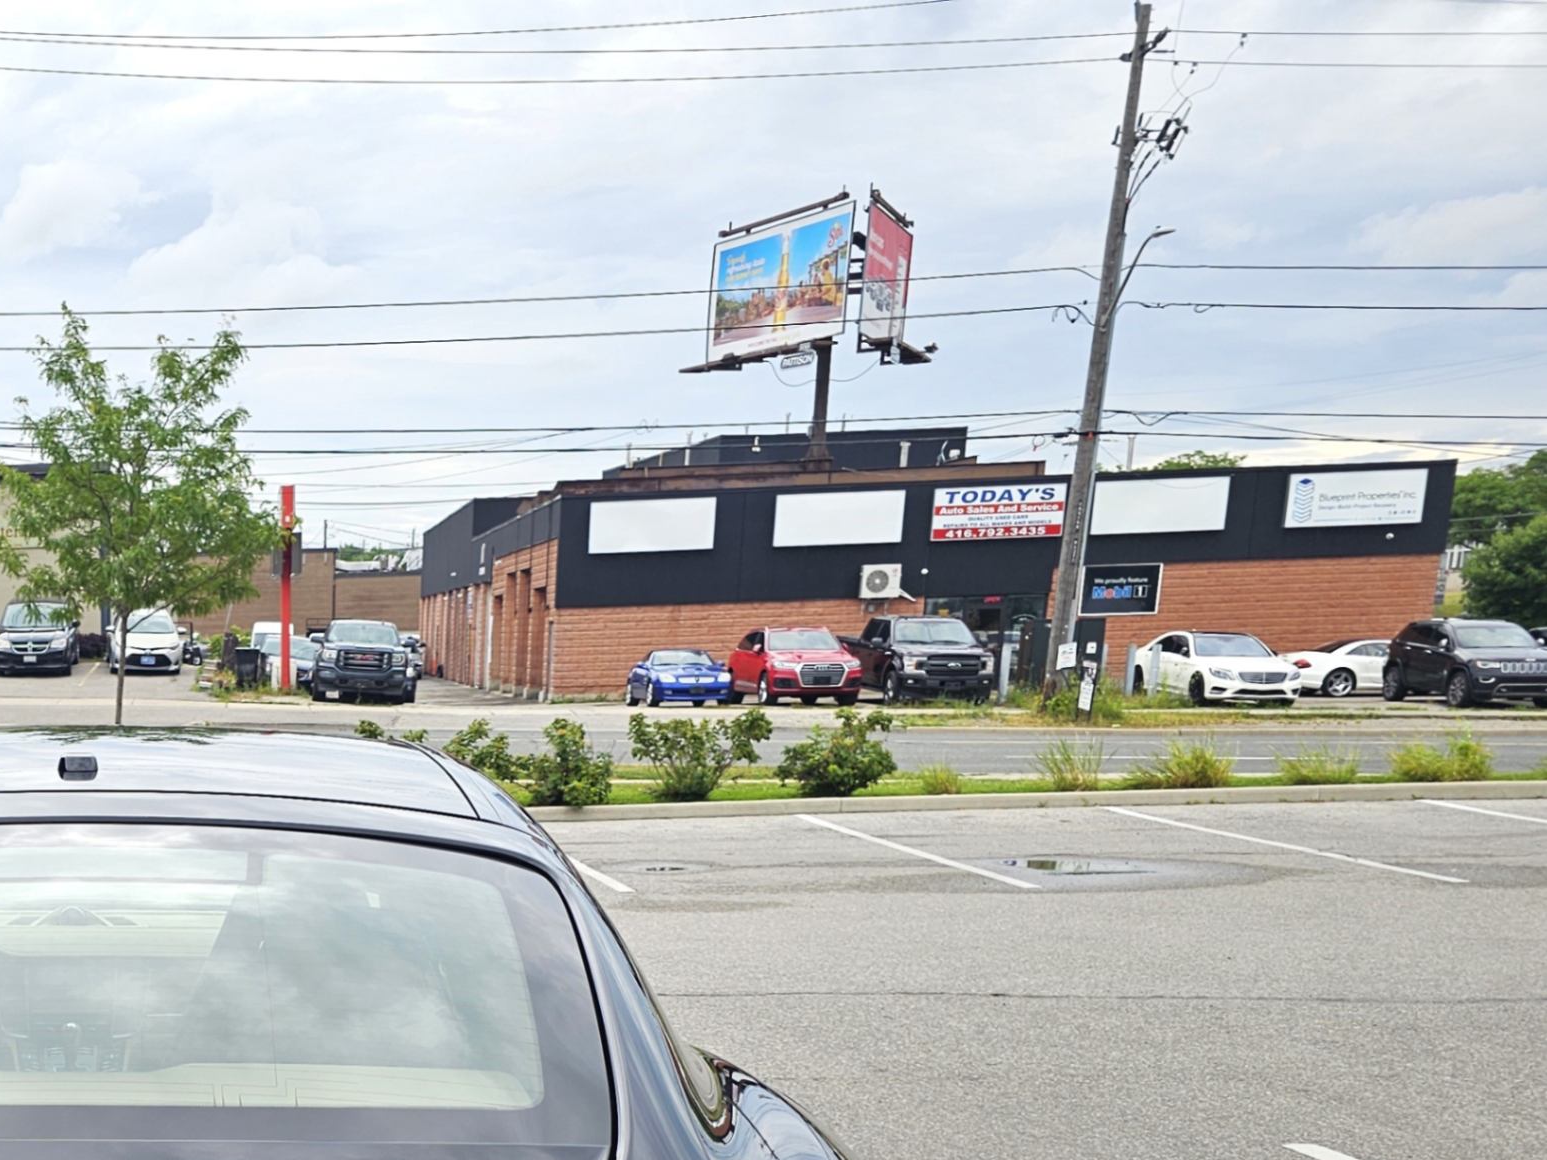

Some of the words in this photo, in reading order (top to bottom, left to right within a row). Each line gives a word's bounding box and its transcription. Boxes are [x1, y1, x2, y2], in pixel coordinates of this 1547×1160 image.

[945, 488, 1055, 504] TODAY'S
[1319, 493, 1355, 502] Blueprint
[939, 506, 964, 515] Auto
[966, 505, 995, 514] Sales
[997, 504, 1017, 513] And
[1020, 503, 1059, 512] Service
[945, 526, 1046, 539] 416.792.3435
[1092, 585, 1132, 599] Mobil
